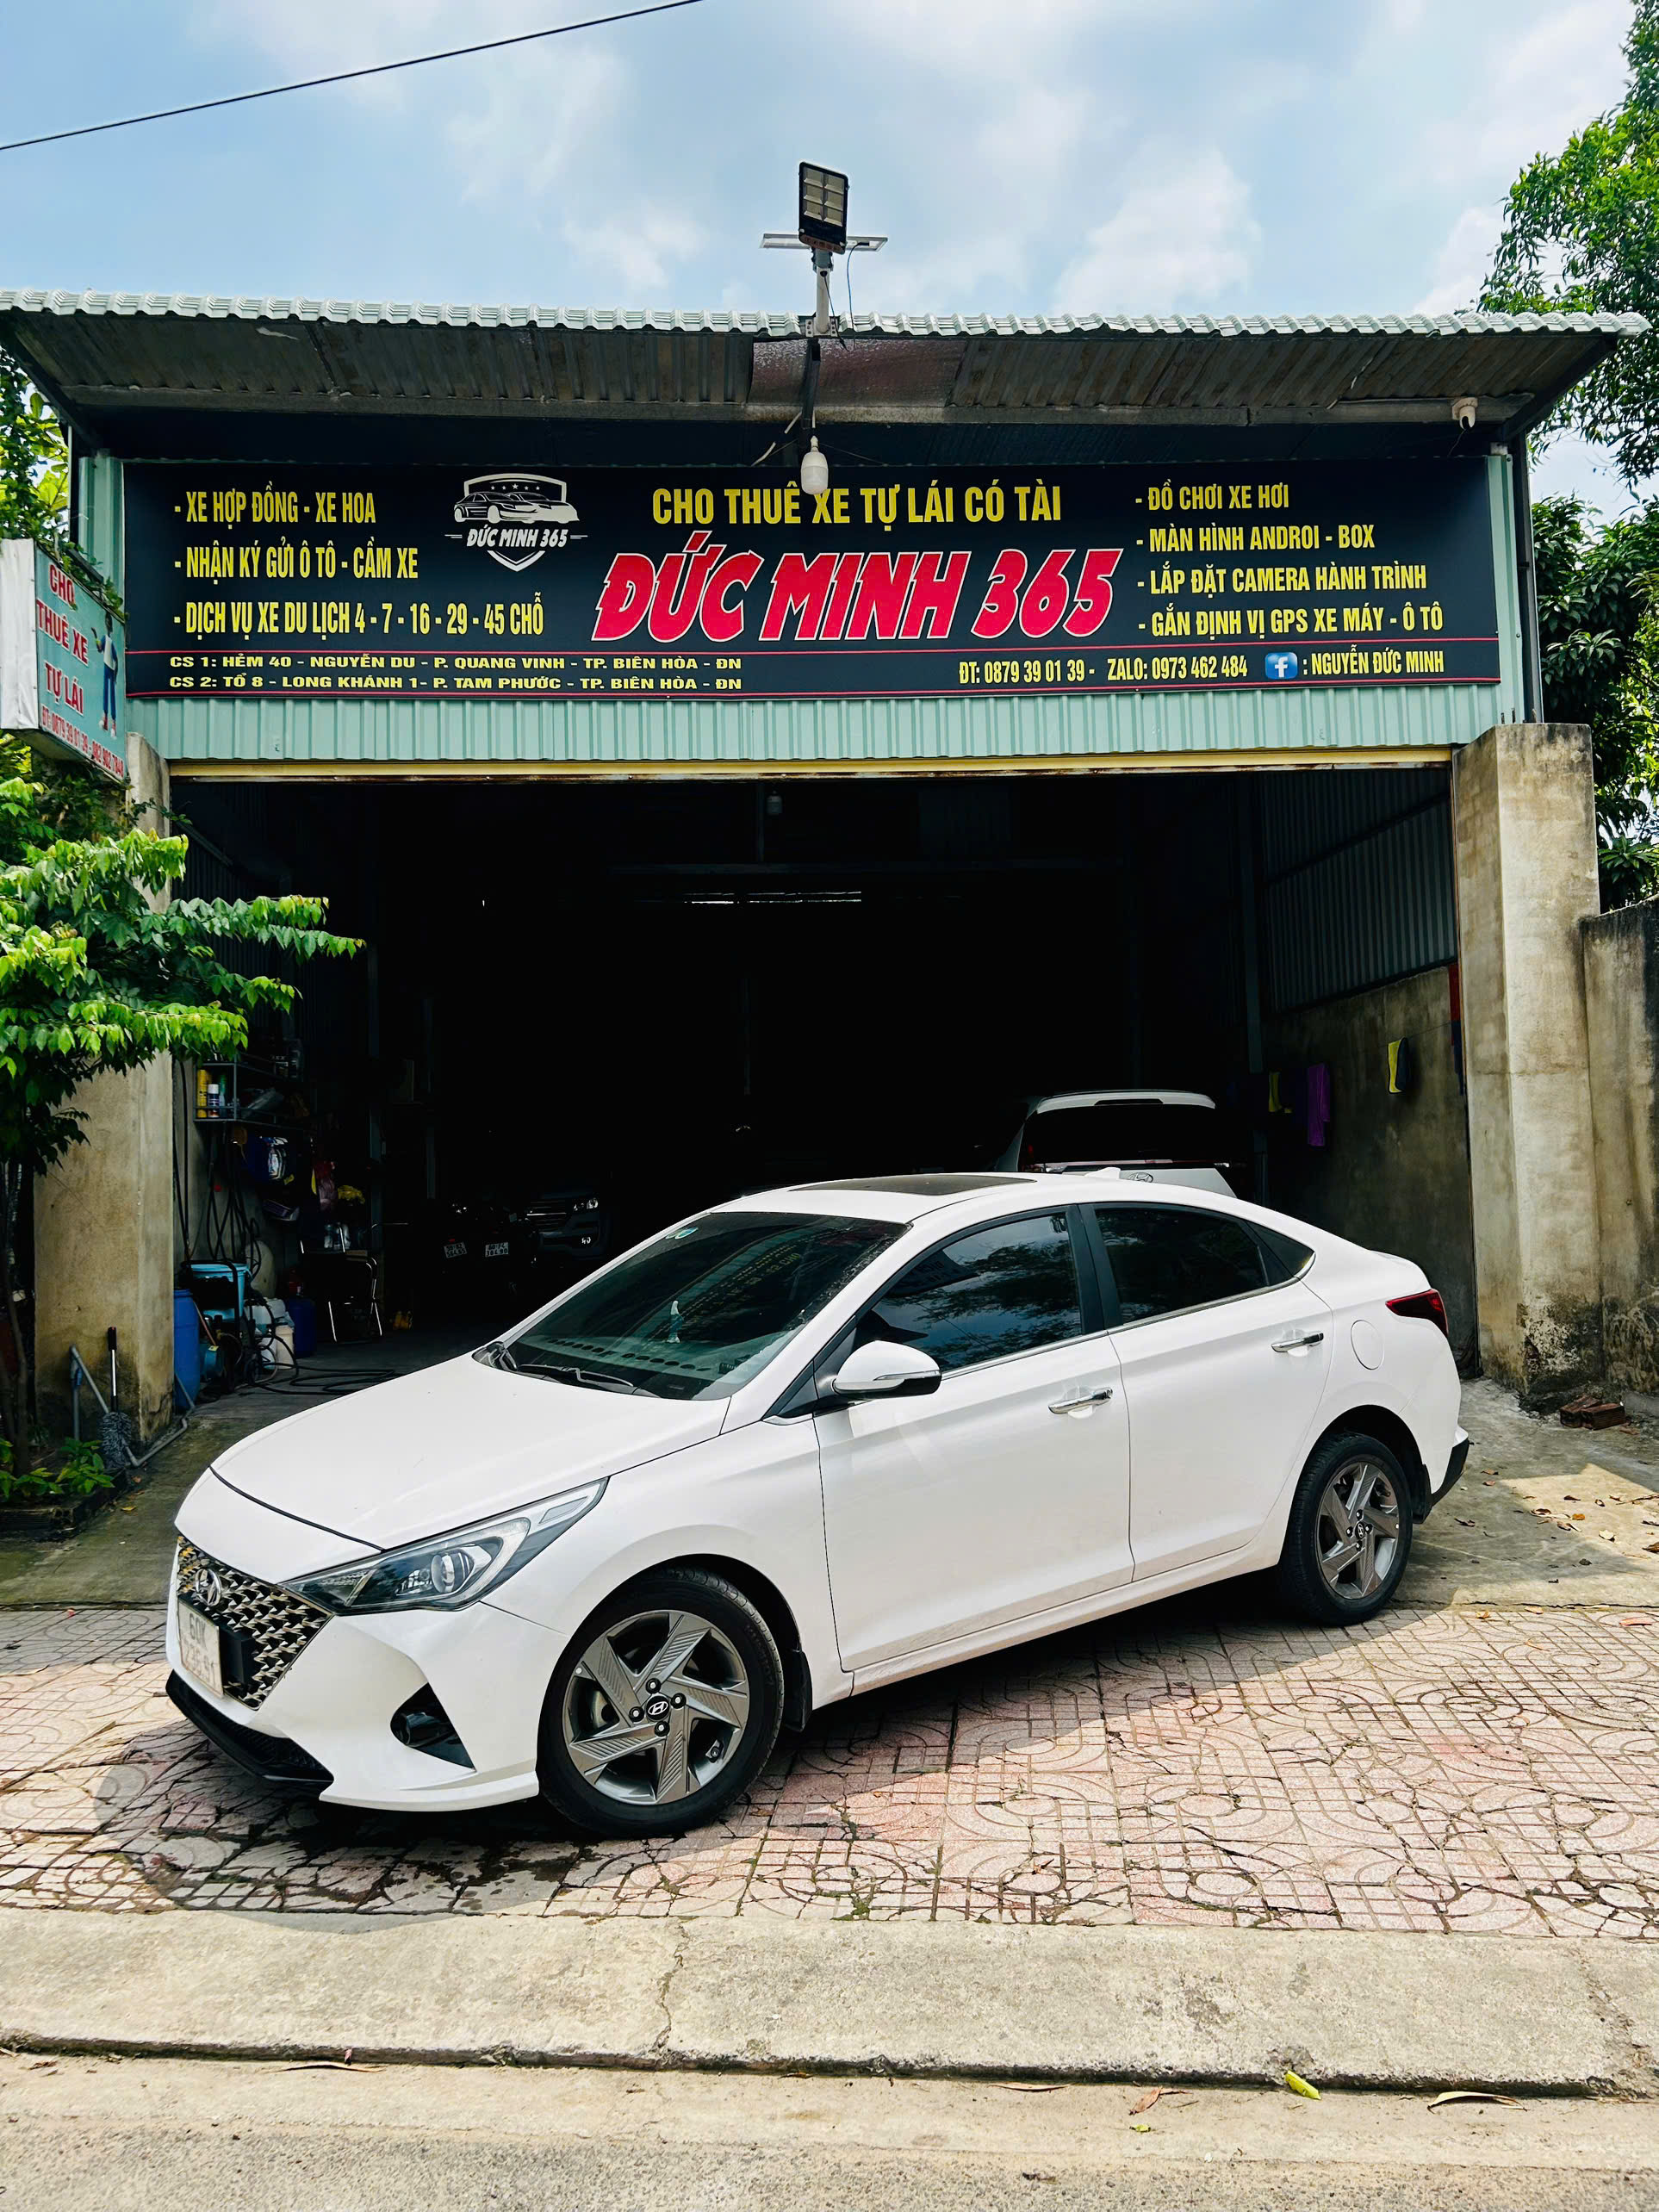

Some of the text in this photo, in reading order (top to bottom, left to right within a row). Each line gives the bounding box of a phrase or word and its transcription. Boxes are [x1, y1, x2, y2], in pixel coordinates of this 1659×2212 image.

[185, 491, 208, 523] XE
[213, 488, 247, 530] HỢP
[252, 481, 299, 523] ĐỒNG
[315, 492, 337, 523] XE
[342, 492, 376, 524] HOA
[652, 478, 1061, 531] CHO THUÊ XE TỰ LÁI CÓ TÀI
[1147, 478, 1173, 511] ĐỒ
[1179, 483, 1223, 511] CHƠI
[1228, 485, 1252, 509] XE
[1258, 482, 1289, 509] HƠI
[466, 524, 569, 548] ĐỨC MINH 365
[1149, 523, 1194, 552] MÀN
[1198, 522, 1245, 551] HÌNH
[1249, 525, 1320, 550] ANDROI
[1338, 524, 1376, 549] BOX
[186, 539, 234, 585] NHẬN
[239, 539, 261, 578] KÝ
[265, 535, 295, 578] GỬI
[299, 539, 311, 579] Ô
[315, 539, 336, 579] TÔ
[353, 536, 392, 579] CẦM
[396, 547, 419, 579] XE
[1150, 561, 1185, 594] LẮP
[1190, 563, 1227, 599] ĐẶT
[1232, 567, 1311, 593] CAMERA
[1315, 563, 1367, 591] HÀNH
[1370, 560, 1427, 590] TRÌNH
[49, 563, 76, 605] CHO
[592, 530, 1124, 643] ĐỨC MINH 365
[36, 599, 88, 665] THUÊ XE
[185, 601, 227, 641] DỊCH
[230, 601, 253, 641] VỤ
[257, 601, 279, 633] XE
[284, 601, 308, 634] DU
[312, 601, 350, 641] LỊCH
[354, 602, 366, 634] 4
[382, 602, 393, 634] 7
[409, 602, 431, 635] 16
[446, 602, 468, 635] 29
[483, 603, 505, 635] 45
[509, 591, 544, 636] CHỖ
[1151, 602, 1191, 637] GẮN
[1195, 610, 1242, 641] ĐỊNH
[1246, 609, 1265, 640] VỊ
[1270, 608, 1308, 634] GPS
[1313, 607, 1338, 633] XE
[1342, 601, 1384, 632] MÁY
[1402, 601, 1415, 631] Ô
[1419, 600, 1444, 631] TÔ
[169, 676, 195, 688] CS
[199, 676, 217, 687] 2:
[251, 676, 264, 687] 8
[282, 676, 332, 688] LONG
[338, 674, 403, 688] KHÁNH
[432, 677, 449, 689] P.
[453, 677, 493, 689] TAM
[579, 678, 605, 689] TP.
[610, 675, 655, 690] BIÊN
[660, 675, 698, 690] HÒA
[715, 678, 742, 690] ĐN
[170, 656, 195, 668] CS
[200, 656, 217, 668] 1:
[268, 656, 292, 668] 40
[390, 656, 415, 668] DU
[433, 656, 449, 668] P.
[454, 656, 517, 670] QUANG
[521, 657, 565, 669] VINH
[582, 657, 608, 669] TP.
[612, 656, 656, 669] BIÊN
[661, 655, 699, 669] HÒA
[715, 658, 742, 669] ĐN
[959, 661, 980, 684] ĐT:
[984, 660, 1020, 684] 0879
[1023, 660, 1041, 683] 39
[1045, 659, 1061, 683] 01
[1066, 658, 1085, 682] 39
[1107, 656, 1148, 681] ZALO:
[1151, 656, 1187, 680] 0973
[1190, 656, 1218, 679] 462
[1221, 655, 1248, 678] 484
[1311, 643, 1370, 675] NGUYỄN
[1372, 646, 1402, 674] ĐỨC
[1405, 650, 1445, 674] MINH
[45, 662, 84, 714] TỰ LÁI
